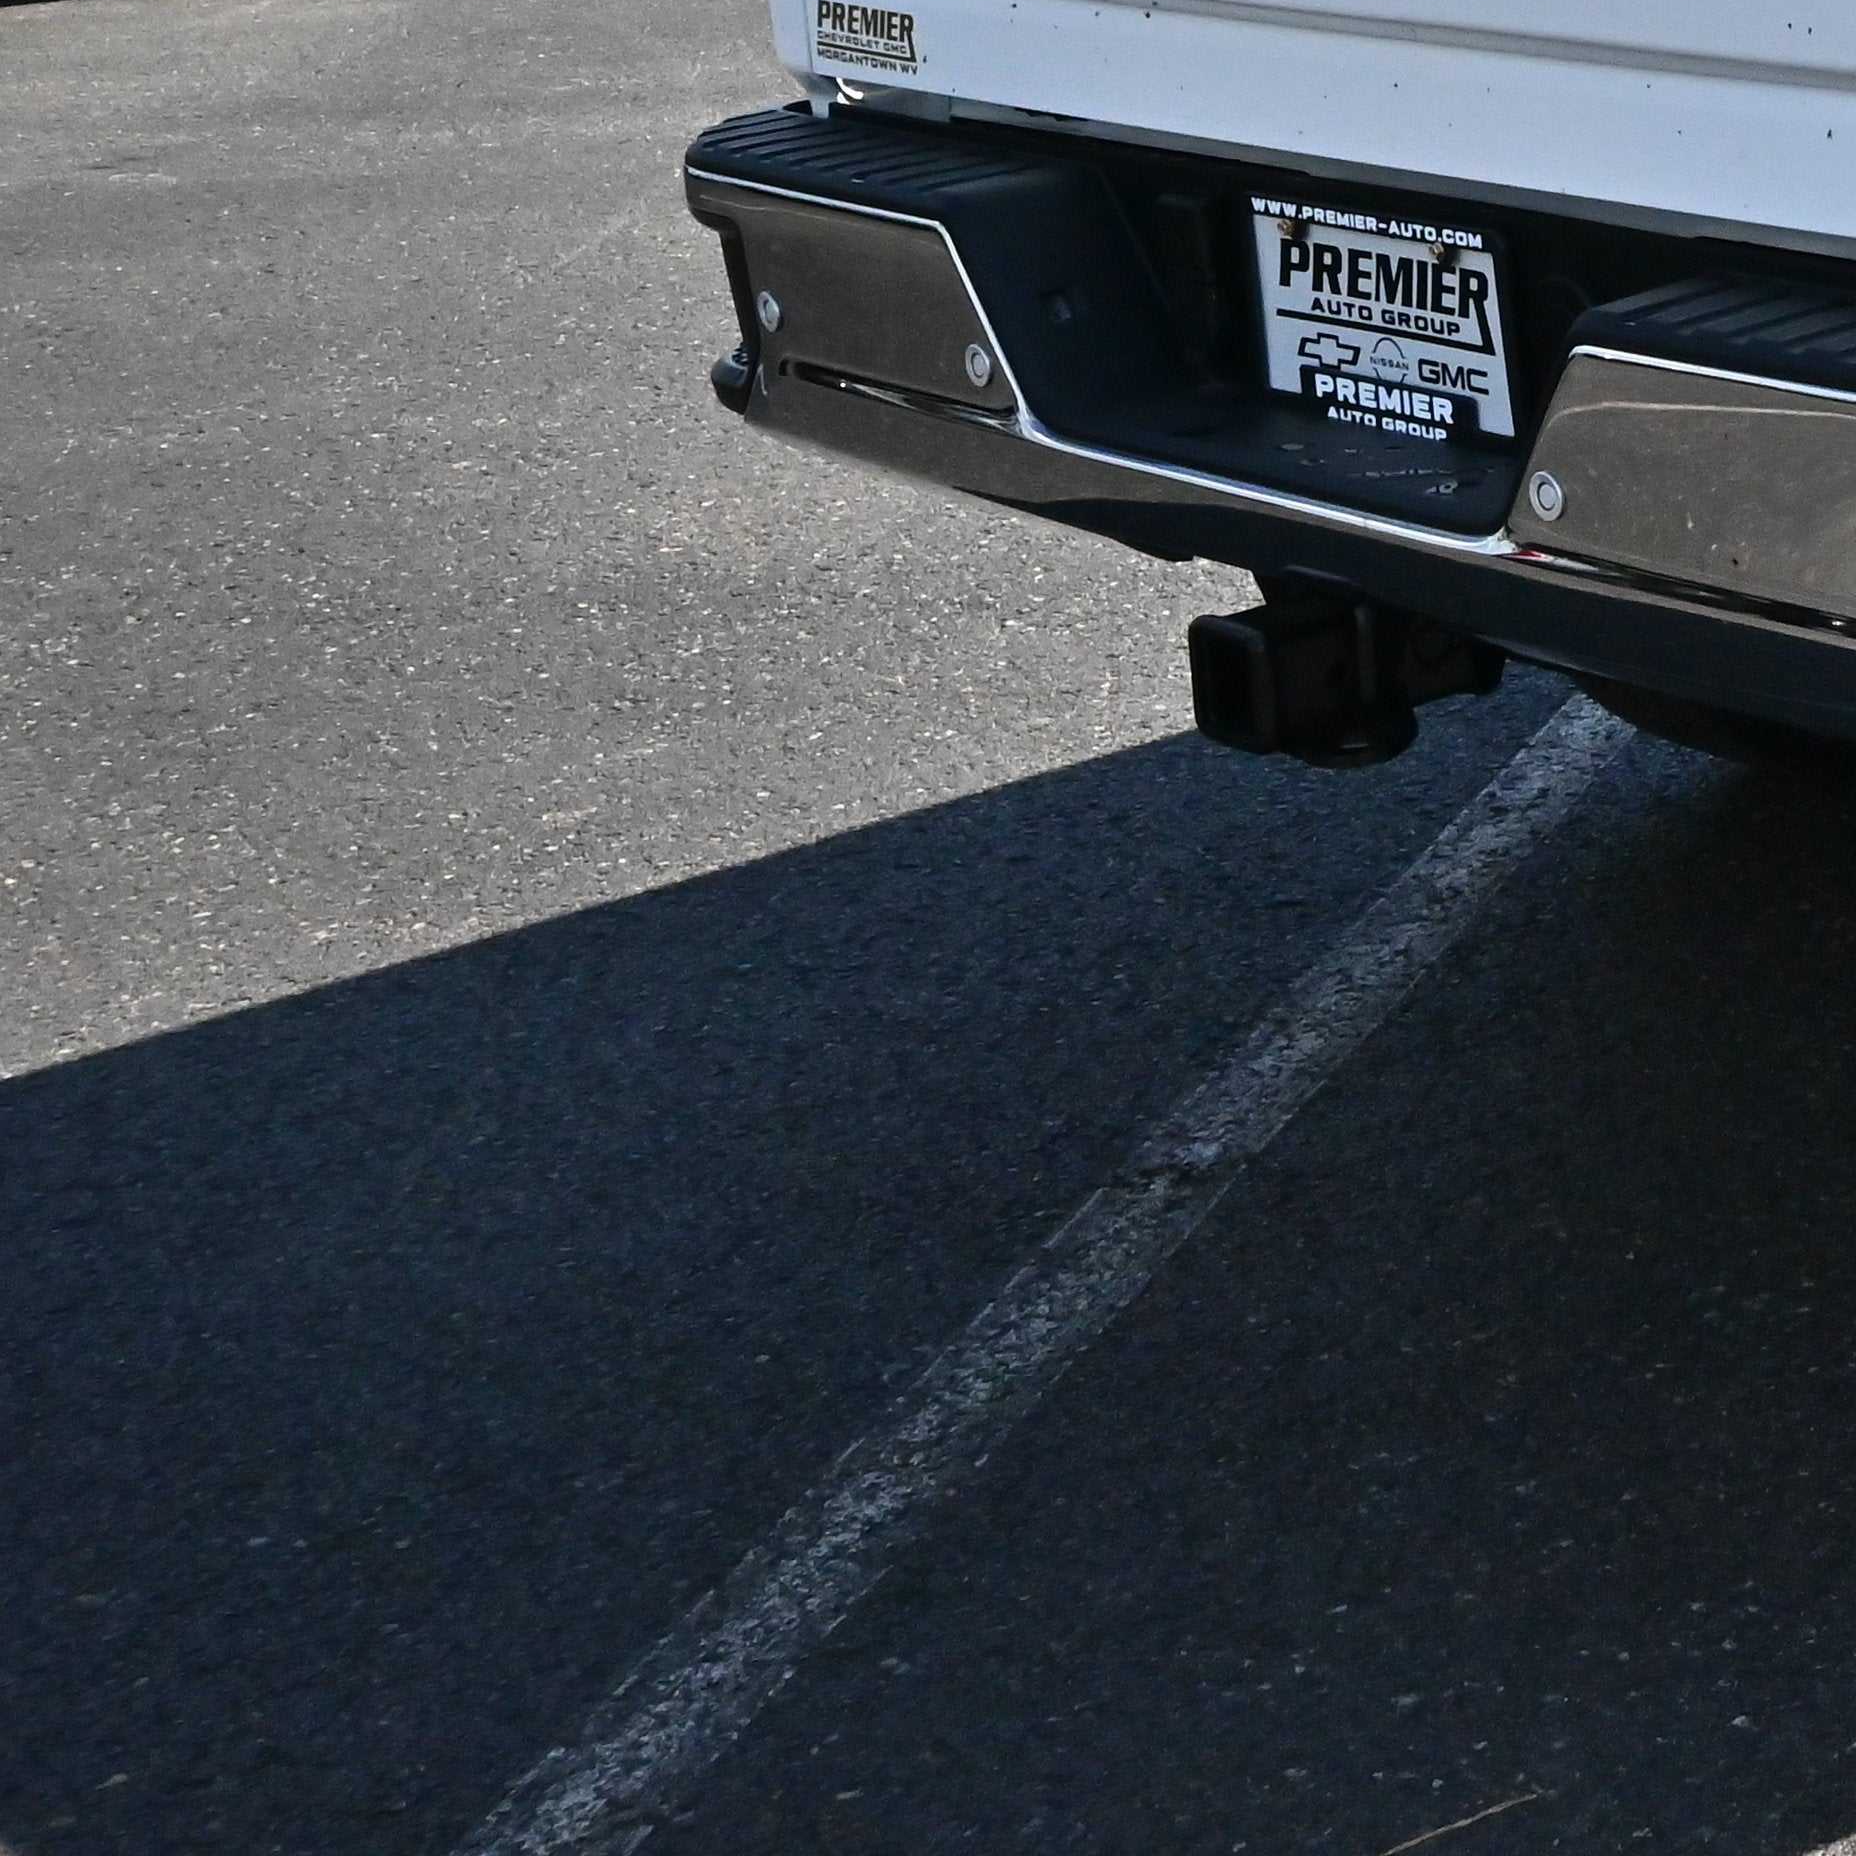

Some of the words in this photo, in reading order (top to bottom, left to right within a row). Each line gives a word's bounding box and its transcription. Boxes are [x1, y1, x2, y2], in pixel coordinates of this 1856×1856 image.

[817, 0, 916, 44] PREMIER
[816, 30, 880, 50] CHEVROLET
[882, 43, 908, 55] GMC
[816, 47, 898, 73] MORGANTOWN
[899, 63, 919, 76] WV
[1251, 196, 1483, 250] WWW.PREMIER-AUTO.COM
[1278, 237, 1491, 322] PREMIER
[1310, 297, 1373, 322] AUTO
[1380, 309, 1461, 337] GROUP
[1369, 355, 1410, 372] NISSAN
[1417, 357, 1490, 396] GMC
[1313, 372, 1454, 424] PREMIER
[1327, 405, 1377, 428] AUTO
[1381, 416, 1448, 442] GROUP
